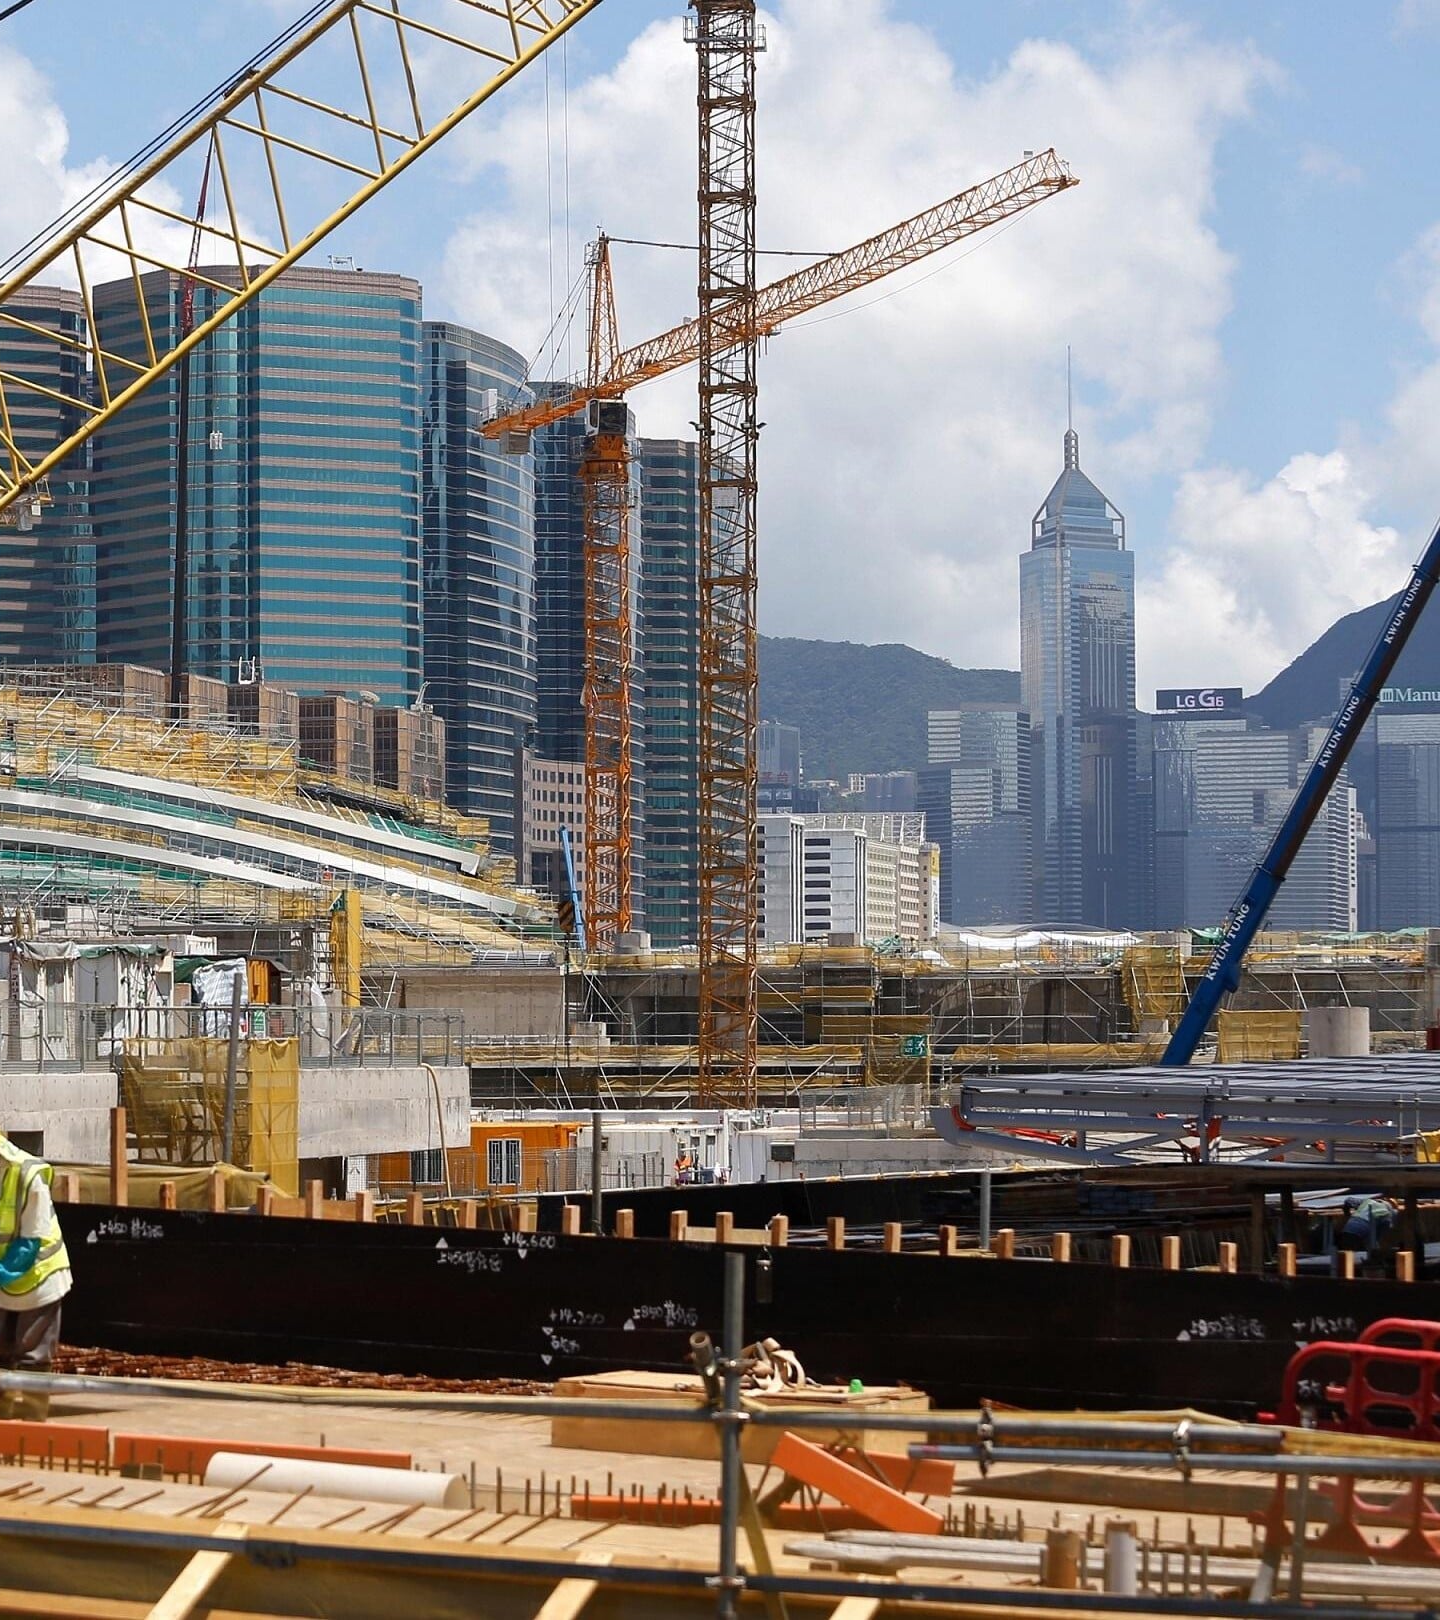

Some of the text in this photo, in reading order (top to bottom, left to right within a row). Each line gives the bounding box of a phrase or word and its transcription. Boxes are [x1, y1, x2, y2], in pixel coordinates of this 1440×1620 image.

[1384, 578, 1422, 644] KWUN TUNG
[1176, 695, 1196, 708] LG
[1318, 695, 1360, 768] KWUN TUNG
[1206, 903, 1250, 981] KWUN TUNG
